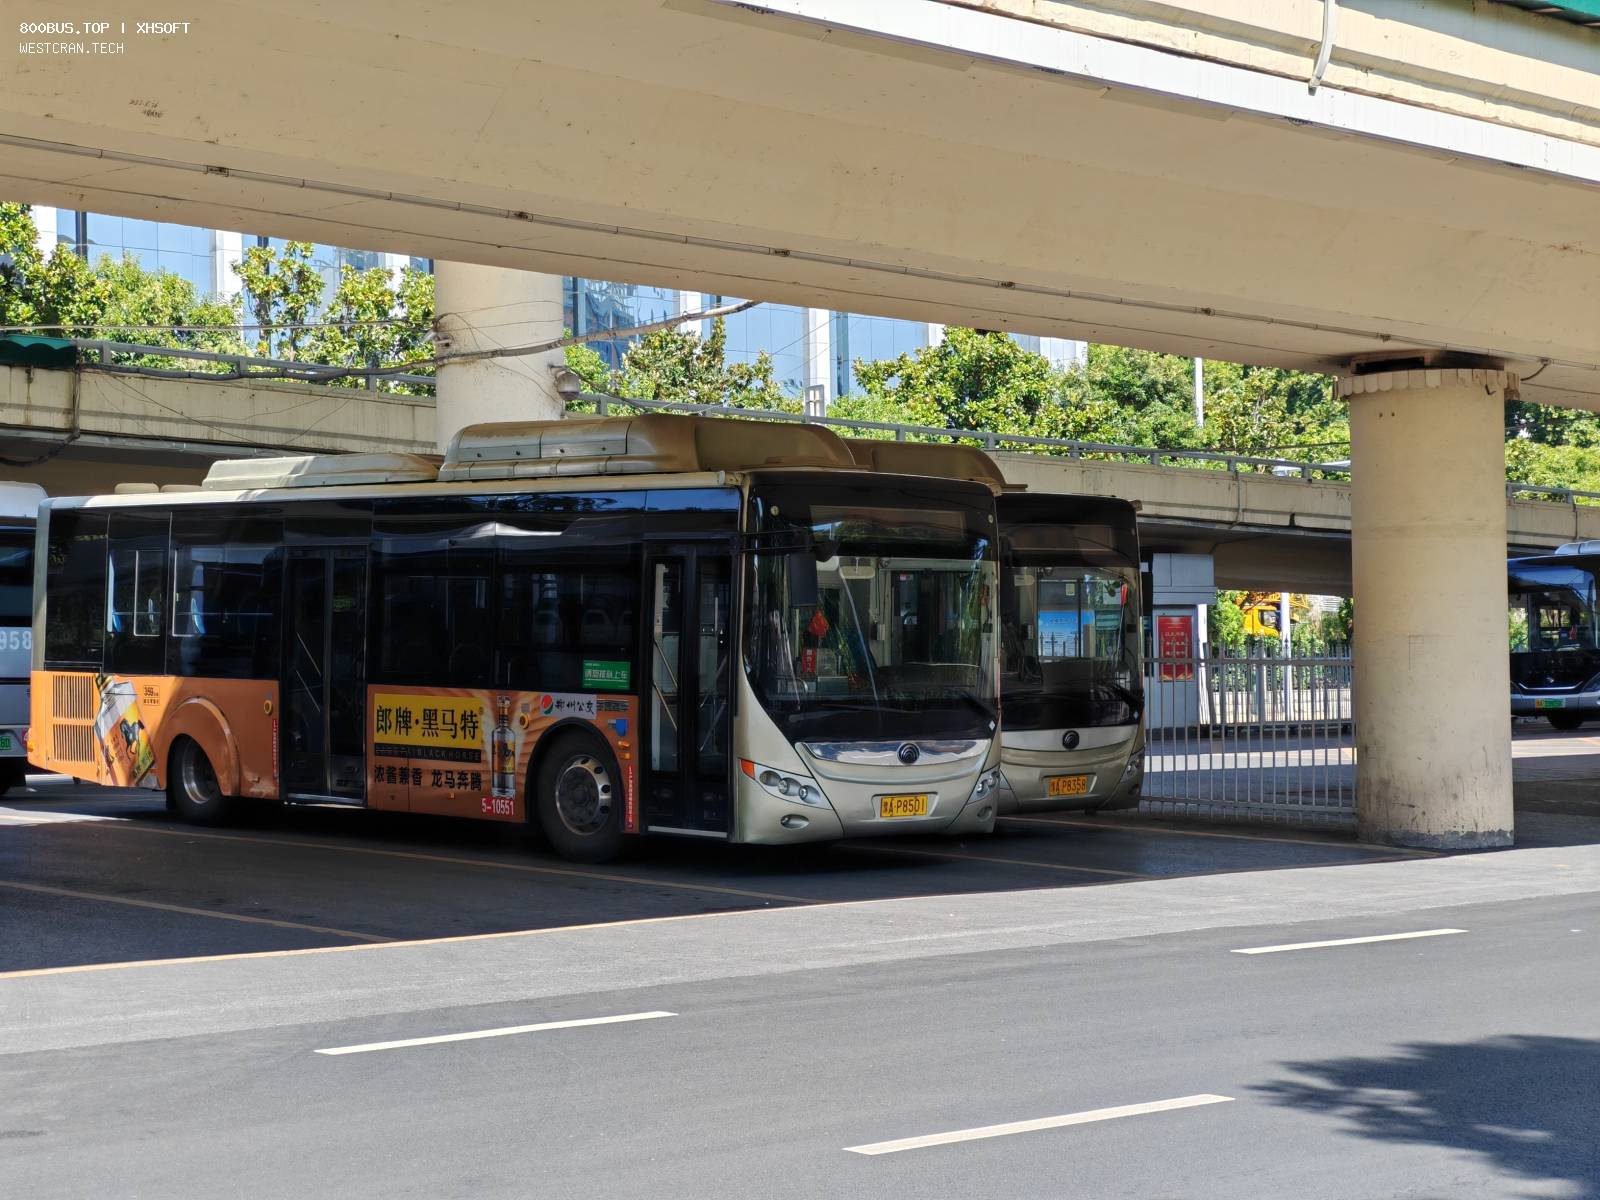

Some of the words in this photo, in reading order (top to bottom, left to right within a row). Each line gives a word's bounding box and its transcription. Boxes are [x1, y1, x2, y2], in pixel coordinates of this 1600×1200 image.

[554, 698, 595, 715] 郑州公交
[374, 764, 423, 786] 浓酱兼香
[431, 769, 482, 791] 龙马奔腾
[480, 798, 514, 816] 5-10551
